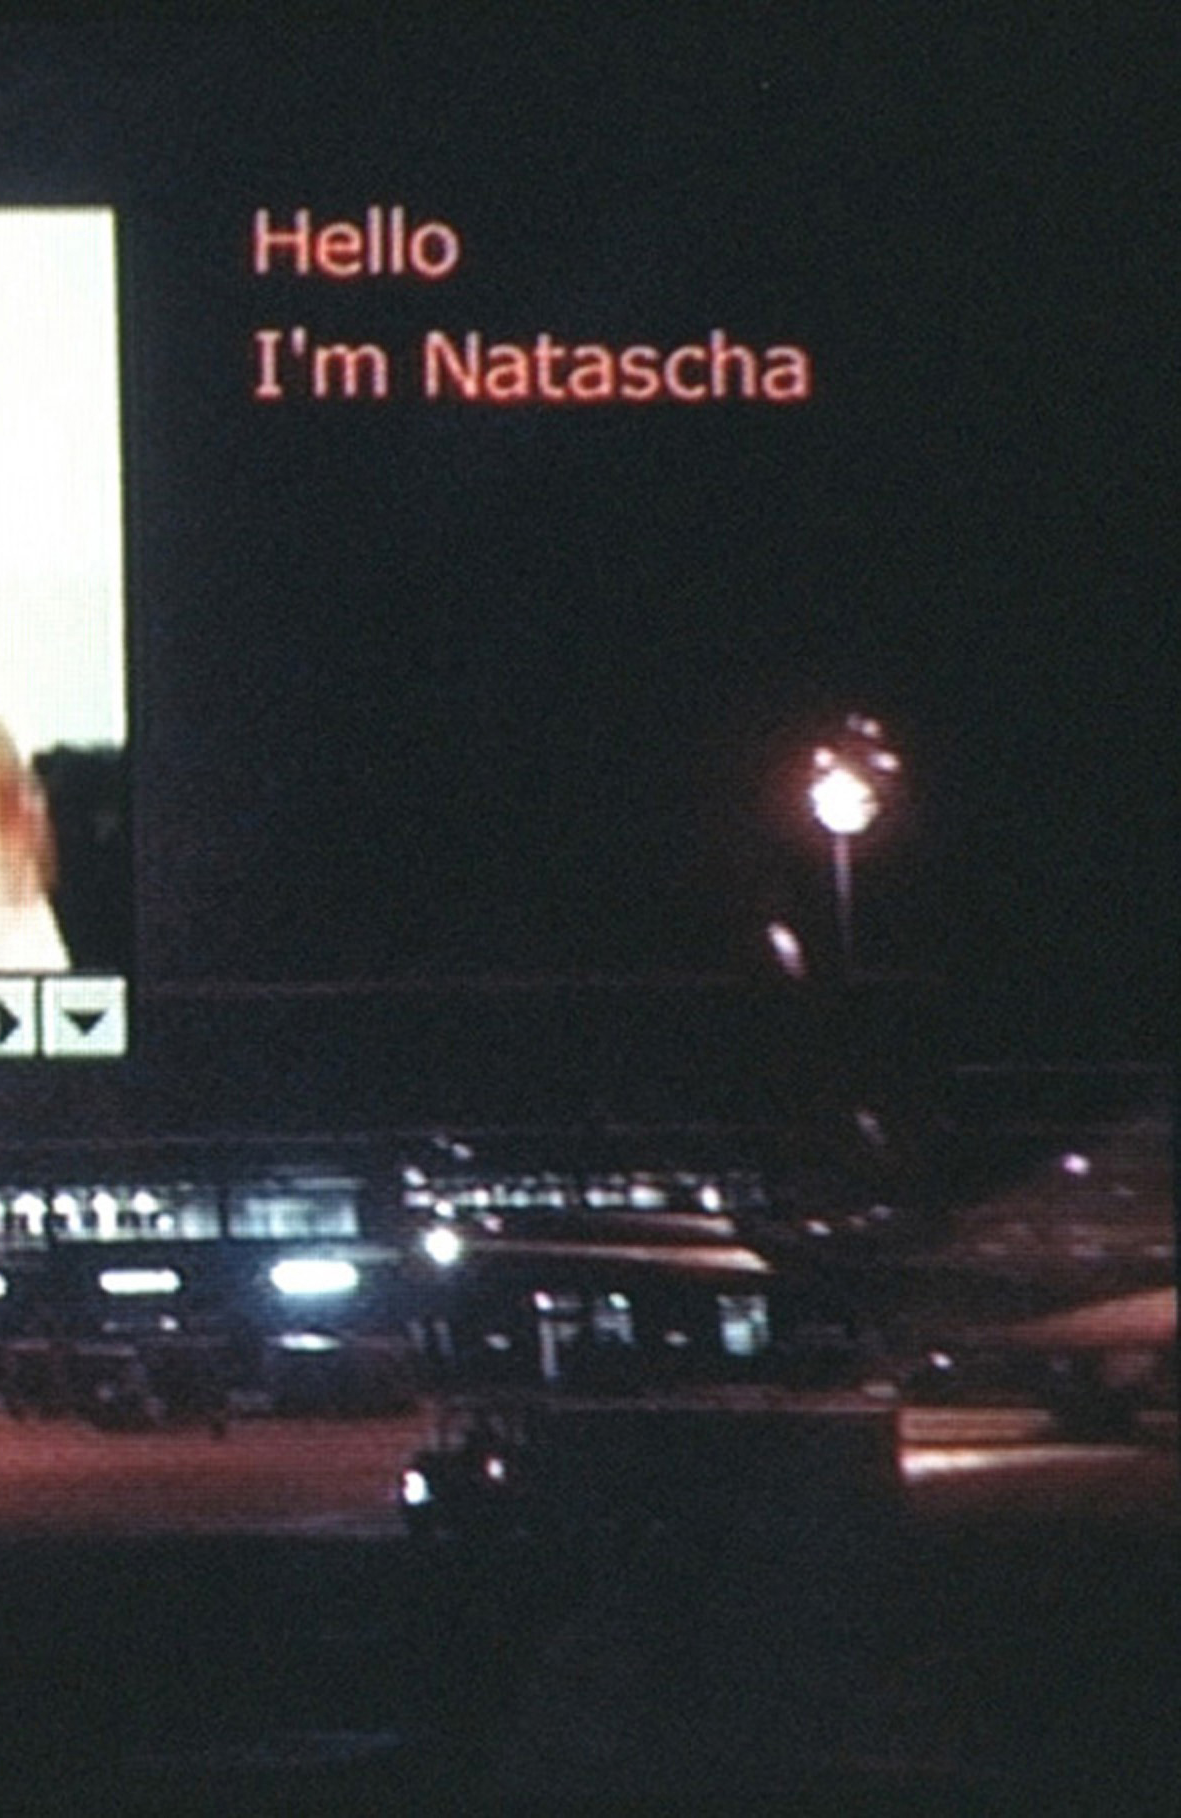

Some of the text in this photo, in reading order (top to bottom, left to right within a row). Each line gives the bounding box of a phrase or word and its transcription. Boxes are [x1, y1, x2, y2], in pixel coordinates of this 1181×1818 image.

[253, 205, 460, 277] Hello
[255, 326, 810, 400] I'm Natascha
